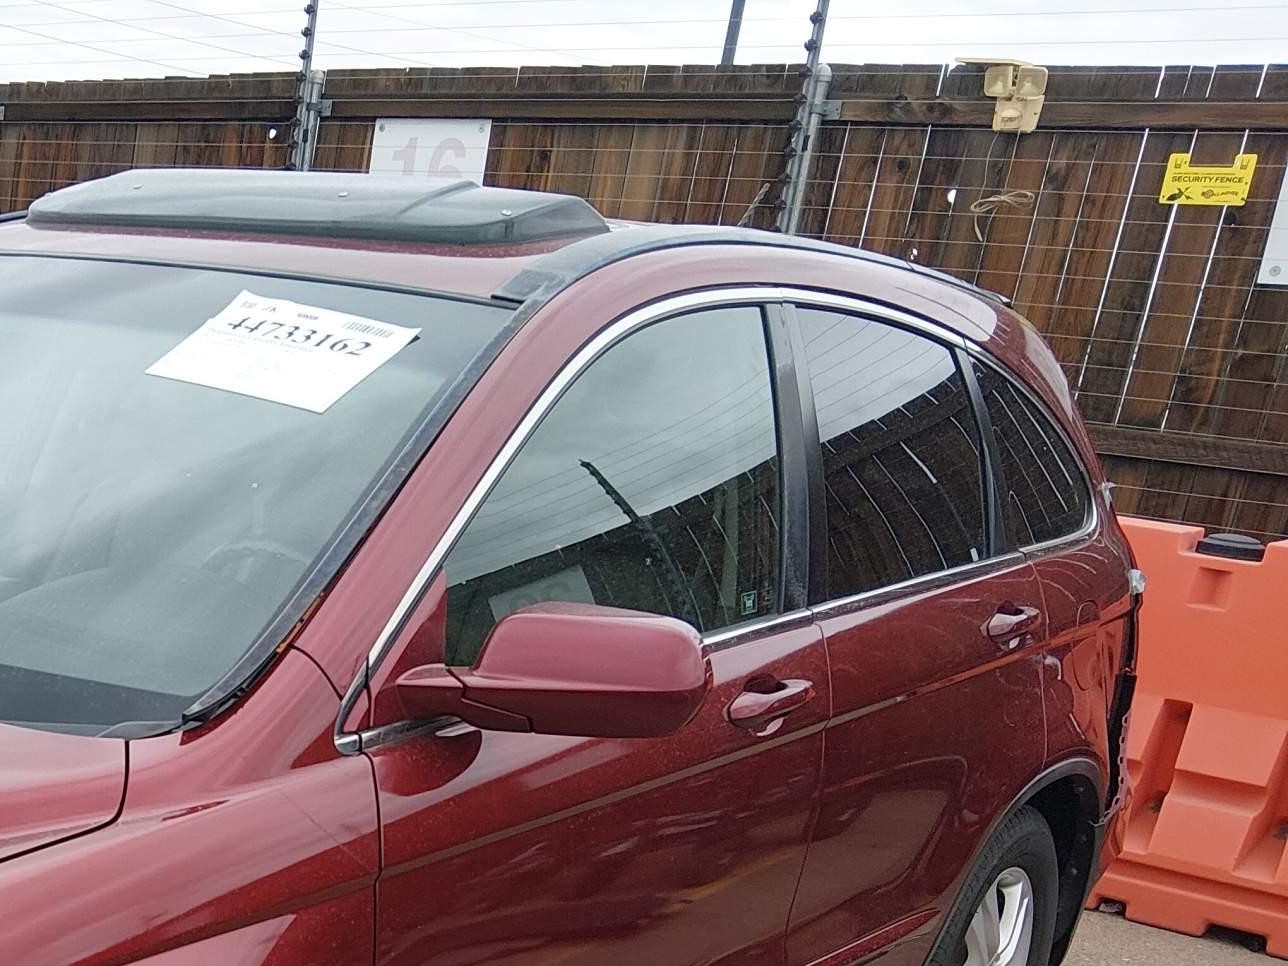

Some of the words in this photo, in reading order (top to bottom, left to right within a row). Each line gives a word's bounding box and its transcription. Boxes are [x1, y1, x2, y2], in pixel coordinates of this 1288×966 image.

[392, 136, 467, 178] 16
[1171, 175, 1214, 184] SECURITY
[1214, 176, 1244, 184] FENCE
[227, 316, 373, 357] 44733162
